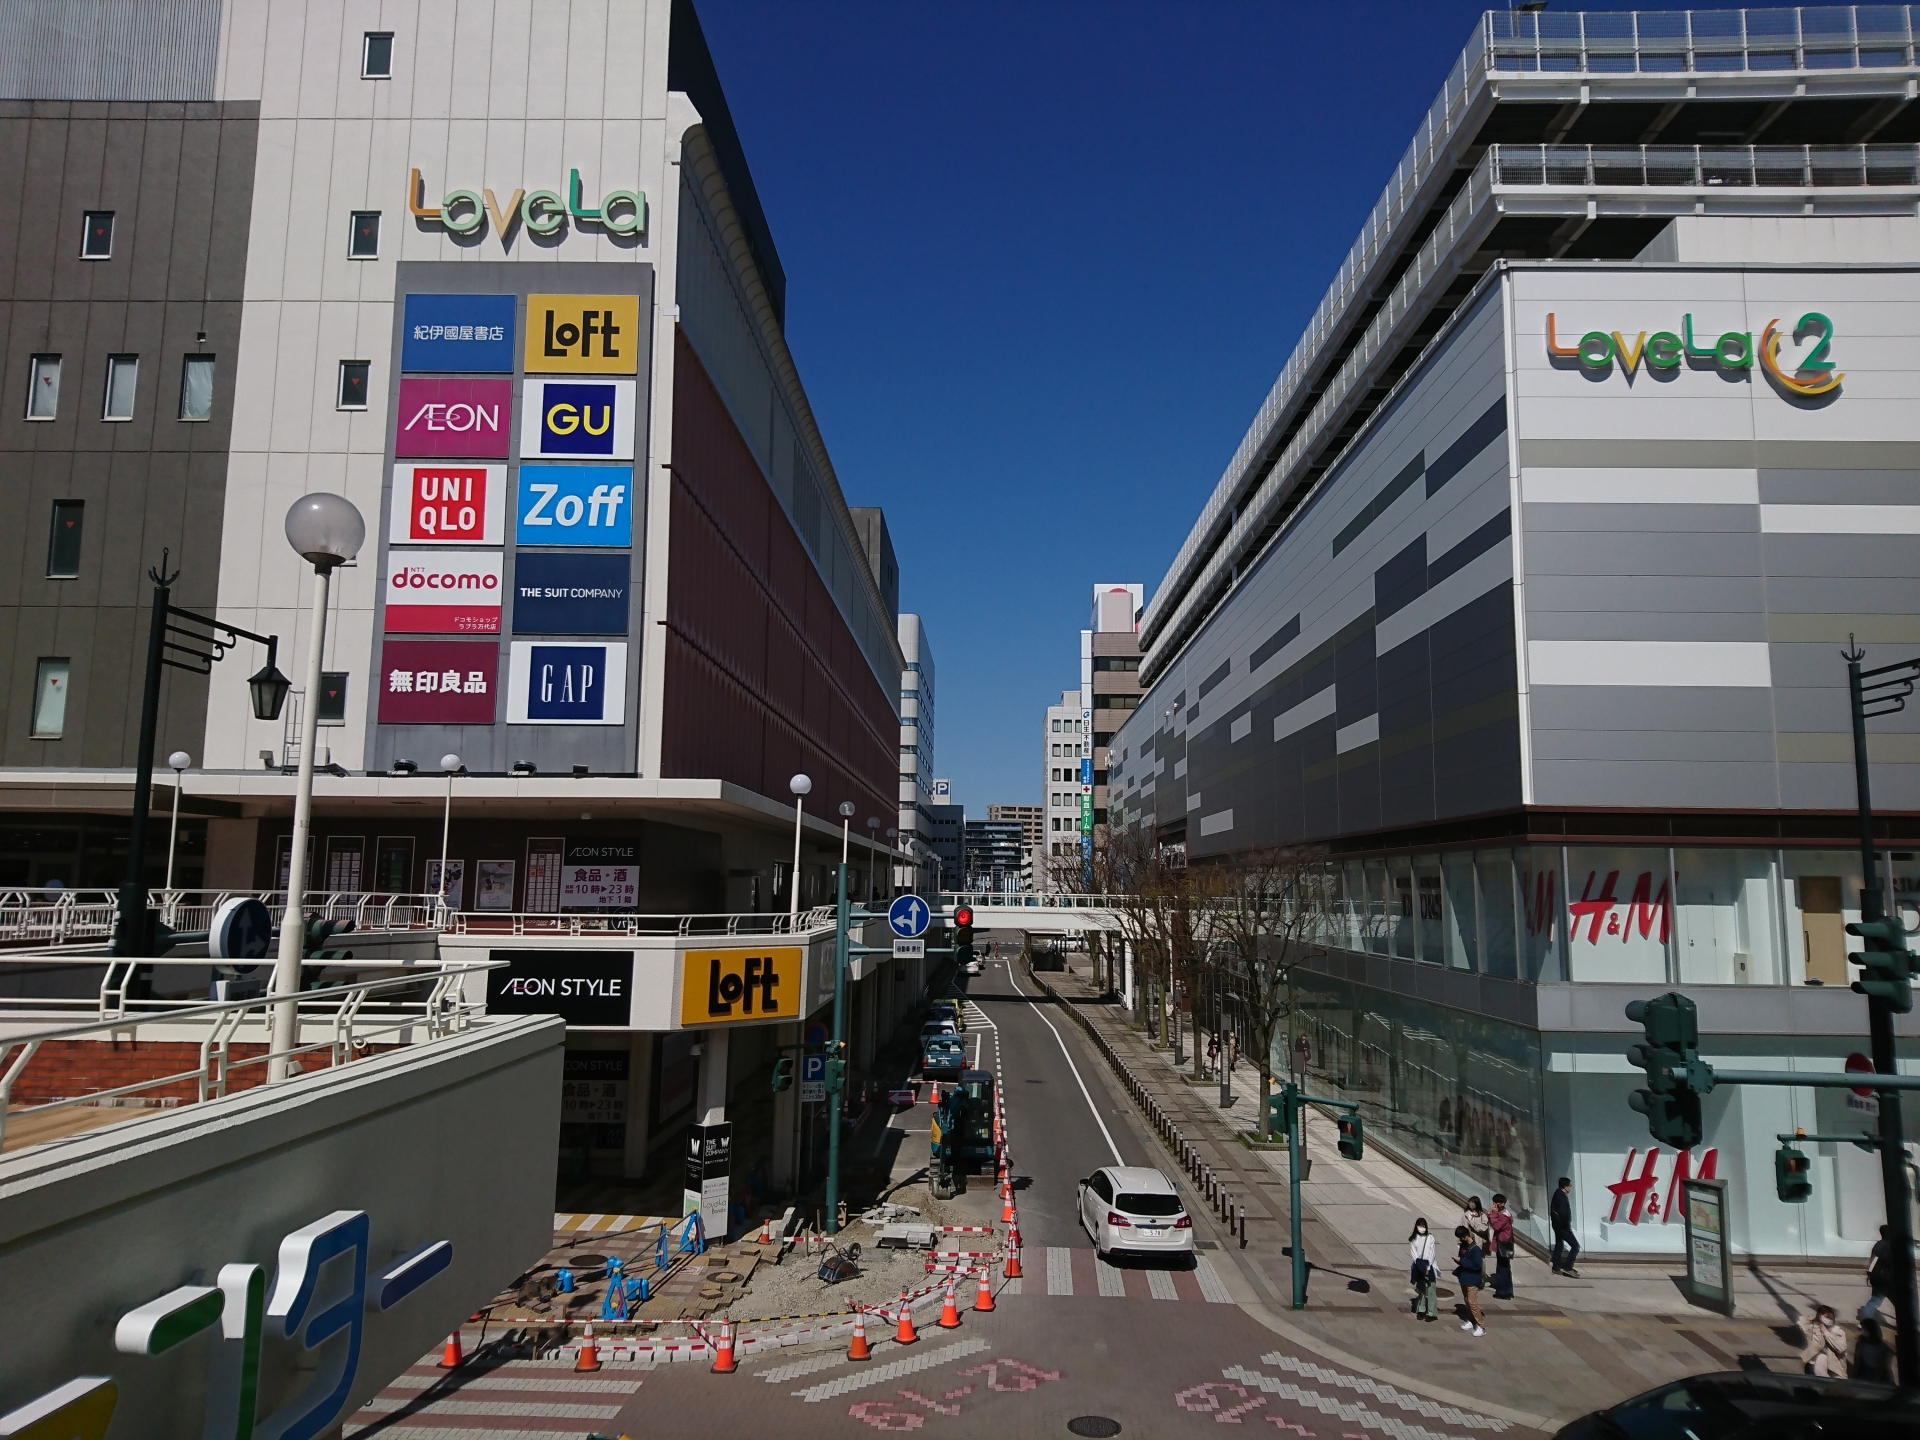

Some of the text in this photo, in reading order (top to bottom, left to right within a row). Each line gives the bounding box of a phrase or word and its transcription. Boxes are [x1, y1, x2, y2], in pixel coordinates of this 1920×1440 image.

[413, 324, 505, 342] 紀伊國屋書店
[546, 402, 611, 435] GU
[420, 477, 473, 502] UNI
[523, 483, 626, 527] Zoff
[419, 506, 476, 535] QLO
[392, 567, 498, 590] docomo
[520, 587, 623, 599] THE SUIT COMPANY
[453, 616, 498, 624] ドコモショップ
[458, 623, 497, 631] ラブラ万代店
[388, 669, 487, 694] 無印良品
[540, 663, 594, 703] GAP
[937, 783, 948, 794] P
[601, 847, 634, 857] STYLE
[574, 868, 628, 882] 食品・酒
[1570, 870, 1679, 945] H&M
[561, 978, 622, 997] STYLE
[807, 1057, 822, 1079] P
